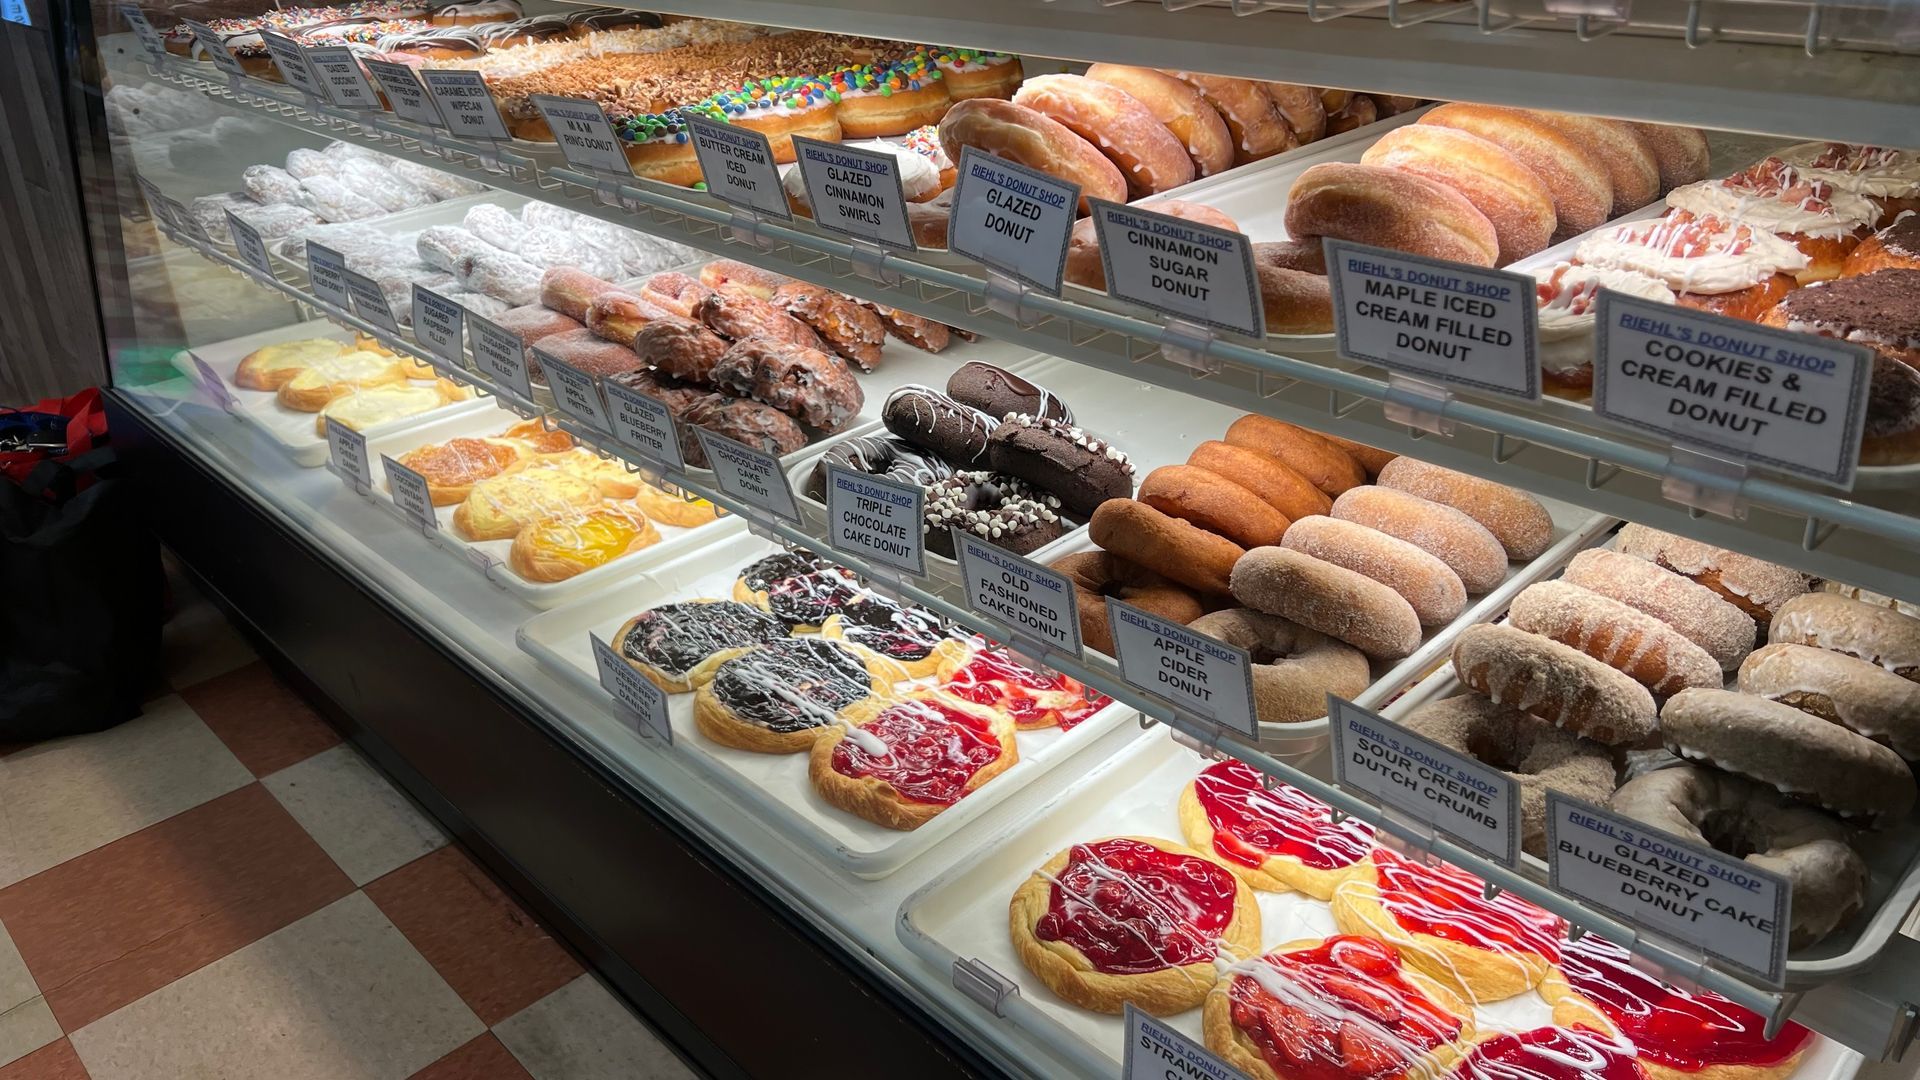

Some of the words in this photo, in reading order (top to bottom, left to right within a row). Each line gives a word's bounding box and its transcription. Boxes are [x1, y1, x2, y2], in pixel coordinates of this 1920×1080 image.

[324, 64, 350, 72] TOASTED
[330, 77, 358, 85] COCONUT
[342, 89, 361, 97] DONUT
[435, 87, 467, 96] CARAMEL
[468, 88, 484, 97] ICED
[461, 115, 484, 125] DONUT
[566, 121, 573, 130] M
[578, 122, 584, 132] &
[585, 123, 592, 133] M
[564, 134, 584, 147] RING
[586, 138, 614, 152] DONUT
[700, 137, 732, 155] BUTTER
[734, 145, 766, 165] CREAM
[720, 131, 741, 146] DONUT
[742, 137, 762, 151] SHOP
[726, 160, 746, 174] ICED
[805, 148, 834, 164] RIEHL'S
[836, 155, 863, 171] DONUT
[865, 161, 888, 176] SHOP
[727, 174, 756, 191] DONUT
[827, 167, 872, 187] GLAZED
[971, 164, 1005, 187] RIEHL'S
[1006, 177, 1039, 198] DONUT
[1039, 189, 1066, 210] SHOP
[825, 184, 884, 209] CINNAMON
[986, 188, 1042, 221] GLAZED
[838, 204, 881, 226] SWIRLS
[984, 213, 1035, 244] DONUT
[1107, 211, 1150, 231] RIEHL'S
[1153, 223, 1195, 242] DONUT
[1198, 234, 1233, 252] SHOP
[1127, 231, 1218, 265] CINNAMON
[1149, 255, 1209, 282] SUGAR
[1348, 259, 1404, 282] RIEHL'S
[1407, 270, 1462, 293] DONUT
[1465, 281, 1511, 303] SHOP
[1151, 275, 1210, 301] DONUT
[1364, 279, 1437, 308] MAPLE
[1442, 294, 1497, 319] ICED
[423, 317, 454, 337] RASPBERRY
[425, 306, 449, 324] SUGARED
[1356, 301, 1429, 330] CREAM
[1436, 317, 1513, 347] FILLED
[429, 331, 447, 346] FILLED
[482, 334, 511, 356] SUGARED
[1396, 332, 1472, 362] DONUT
[1618, 313, 1693, 344] RIEHL'S
[1696, 330, 1771, 362] DONUT
[1773, 348, 1836, 377] SHOP
[479, 344, 519, 370] STRAWBERRY
[492, 360, 512, 377] FILLED
[1645, 340, 1774, 385] COOKIES
[1782, 372, 1802, 392] &
[556, 372, 583, 391] GLAZED
[565, 387, 587, 403] APPLE
[1621, 359, 1718, 399] CREAM
[1723, 385, 1828, 426] FILLED
[567, 399, 594, 417] FRITTER
[624, 403, 655, 422] GLAZED
[1667, 398, 1769, 437] DONUT
[620, 413, 666, 440] BLUEBERRY
[631, 429, 663, 450] FRITTER
[339, 437, 354, 451] APPLE
[339, 447, 358, 464] CHEESE
[718, 450, 770, 476] CHOCOLATE
[738, 468, 762, 484] CAKE
[399, 485, 424, 505] CUSTARD
[739, 479, 768, 497] DONUT
[837, 478, 863, 494] RIEHL'S
[864, 486, 890, 502] DONUT
[891, 494, 912, 509] SHOP
[404, 499, 424, 516] DANISH
[856, 497, 892, 517] TRIPLE
[844, 511, 906, 540] CHOCOLATE
[844, 528, 871, 546] CAKE
[874, 538, 911, 558] DONUT
[967, 545, 1000, 567] RIEHL'S
[1002, 559, 1034, 581] DONUT
[1036, 574, 1061, 593] SHOP
[1002, 572, 1029, 592] OLD
[981, 578, 1058, 621] FASHIONED
[980, 594, 1015, 618] CAKE
[1019, 612, 1067, 641] DONUT
[1120, 610, 1160, 634] RIEHL'S
[1163, 626, 1202, 650] DONUT
[1204, 644, 1236, 665] SHOP
[1153, 637, 1205, 666] APPLE
[603, 658, 656, 705] BLUEBERRY
[1160, 656, 1208, 684] CIDER
[616, 677, 650, 708] CHEESE
[1158, 670, 1212, 701] DONUT
[619, 689, 651, 720] DANISH
[1349, 720, 1401, 753] RIEHL'S
[1403, 745, 1455, 778] DONUT
[1456, 771, 1498, 798] SHOP
[1357, 738, 1411, 772] SOUR
[1417, 766, 1491, 810] CREME
[1352, 752, 1417, 791] DUTCH
[1423, 787, 1498, 829] CRUMB
[1568, 811, 1634, 846] RIEHL'S
[1638, 837, 1704, 870] DONUT
[1707, 863, 1762, 894] SHOP
[1614, 844, 1710, 889] GLAZED
[1558, 839, 1699, 902] BLUEBERRY
[1704, 898, 1775, 935] CAKE
[1620, 881, 1704, 923] DONUT
[1141, 1022, 1184, 1056] RIEHL'S
[1186, 1051, 1228, 1080] DONUT
